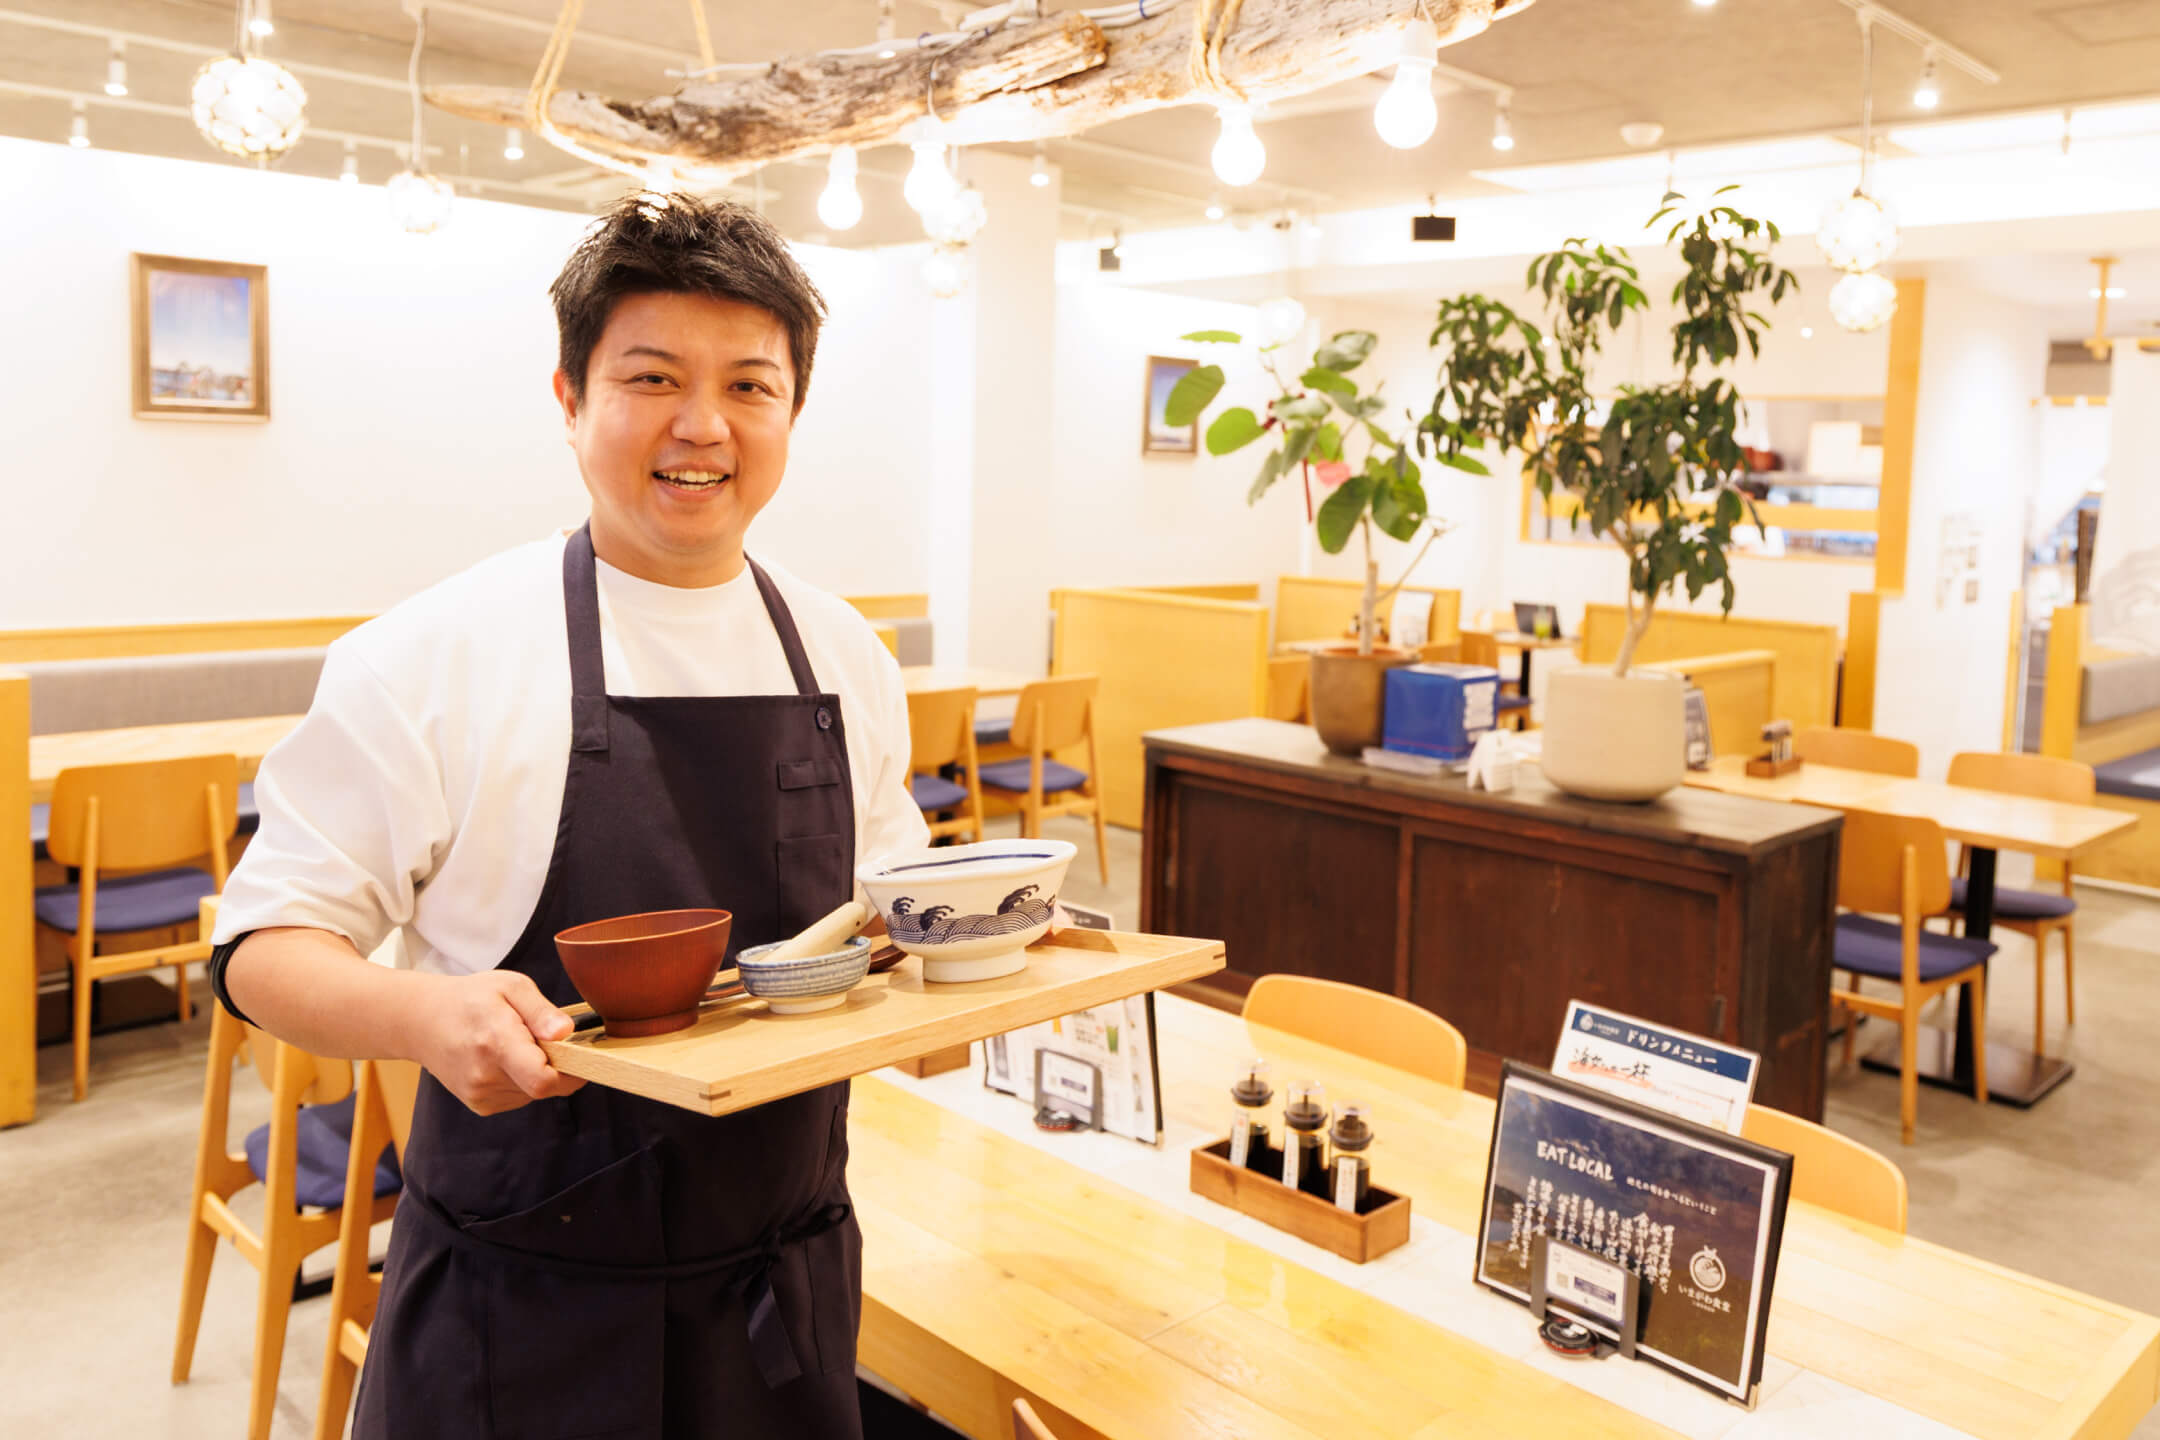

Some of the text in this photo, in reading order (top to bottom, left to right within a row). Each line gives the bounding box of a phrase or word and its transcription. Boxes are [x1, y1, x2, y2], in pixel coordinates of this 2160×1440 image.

[1626, 1029, 1718, 1065] ドリンクメニュー
[1537, 1140, 1614, 1181] EAT LOCAL
